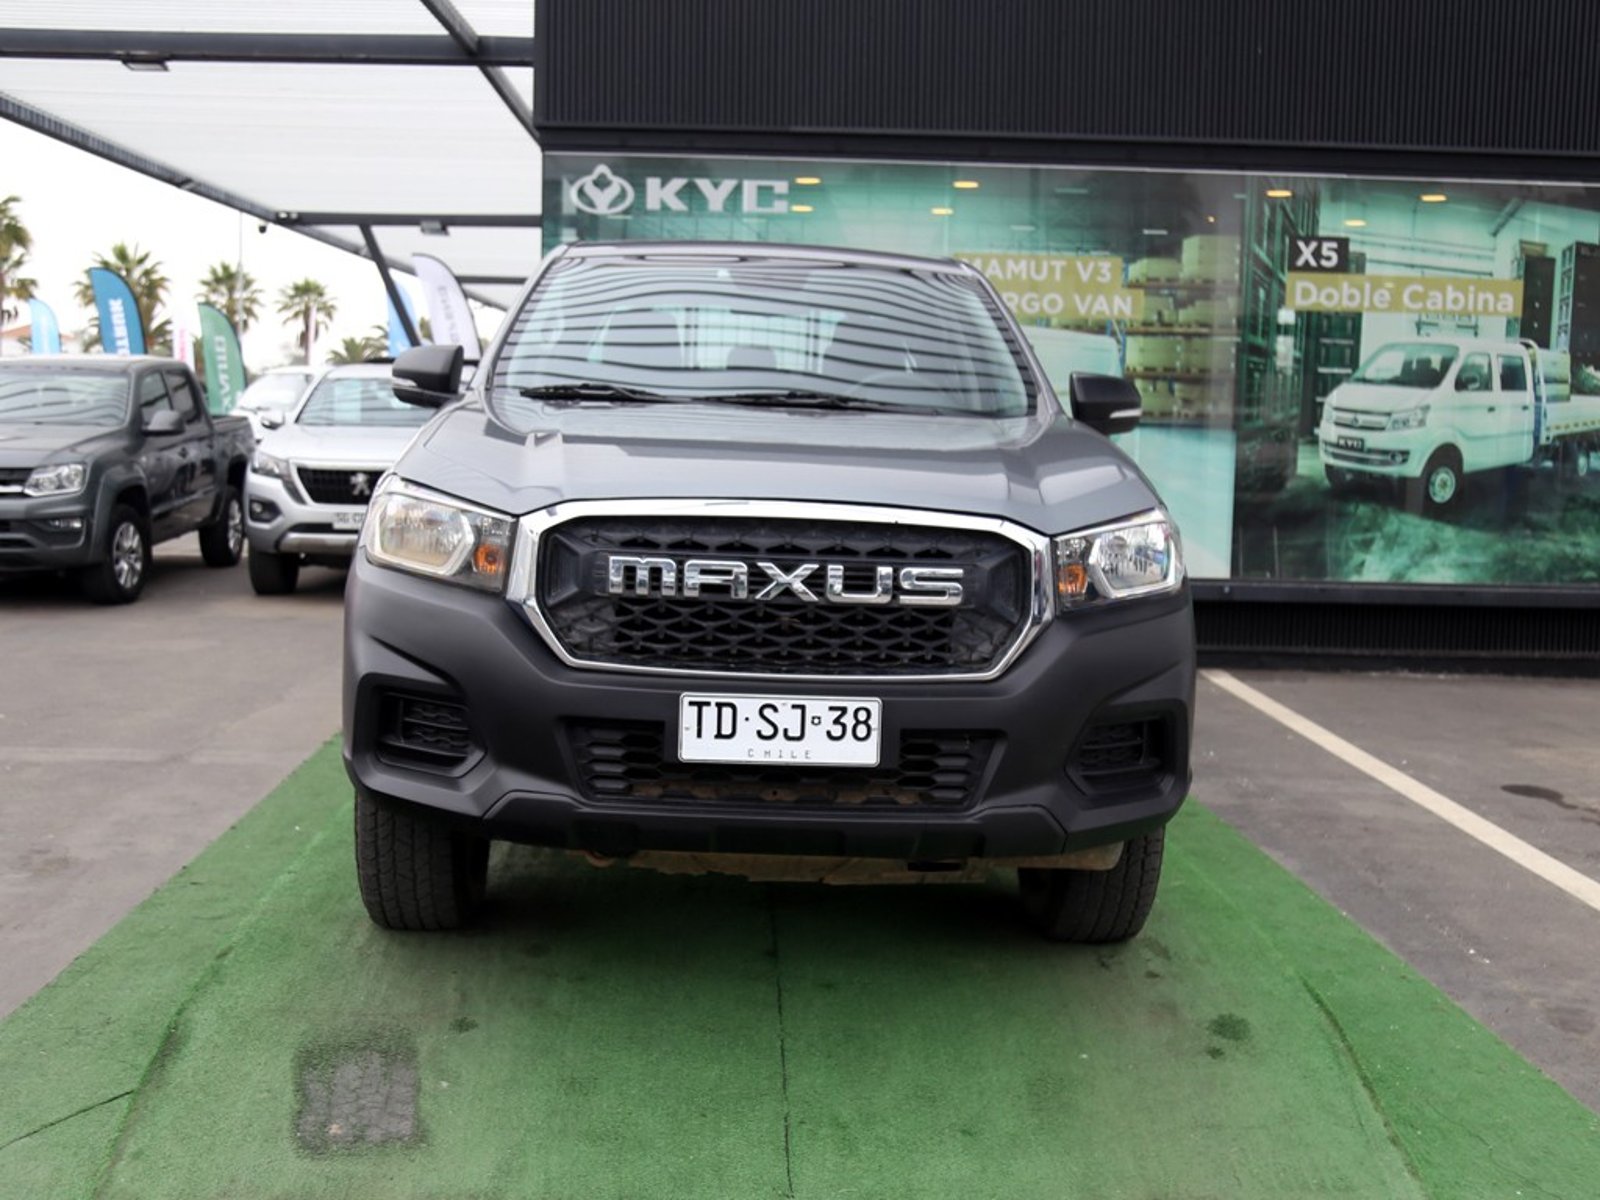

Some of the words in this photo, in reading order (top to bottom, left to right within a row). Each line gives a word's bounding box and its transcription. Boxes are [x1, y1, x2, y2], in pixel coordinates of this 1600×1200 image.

[645, 177, 789, 214] KYC
[1296, 241, 1338, 268] X5
[1076, 260, 1112, 284] V3
[1001, 292, 1064, 315] RGO
[1074, 293, 1132, 317] VAN
[1295, 280, 1391, 309] Doble
[1403, 283, 1514, 313] Cabina
[608, 555, 965, 606] MAXUS
[748, 748, 812, 760] CHILE
